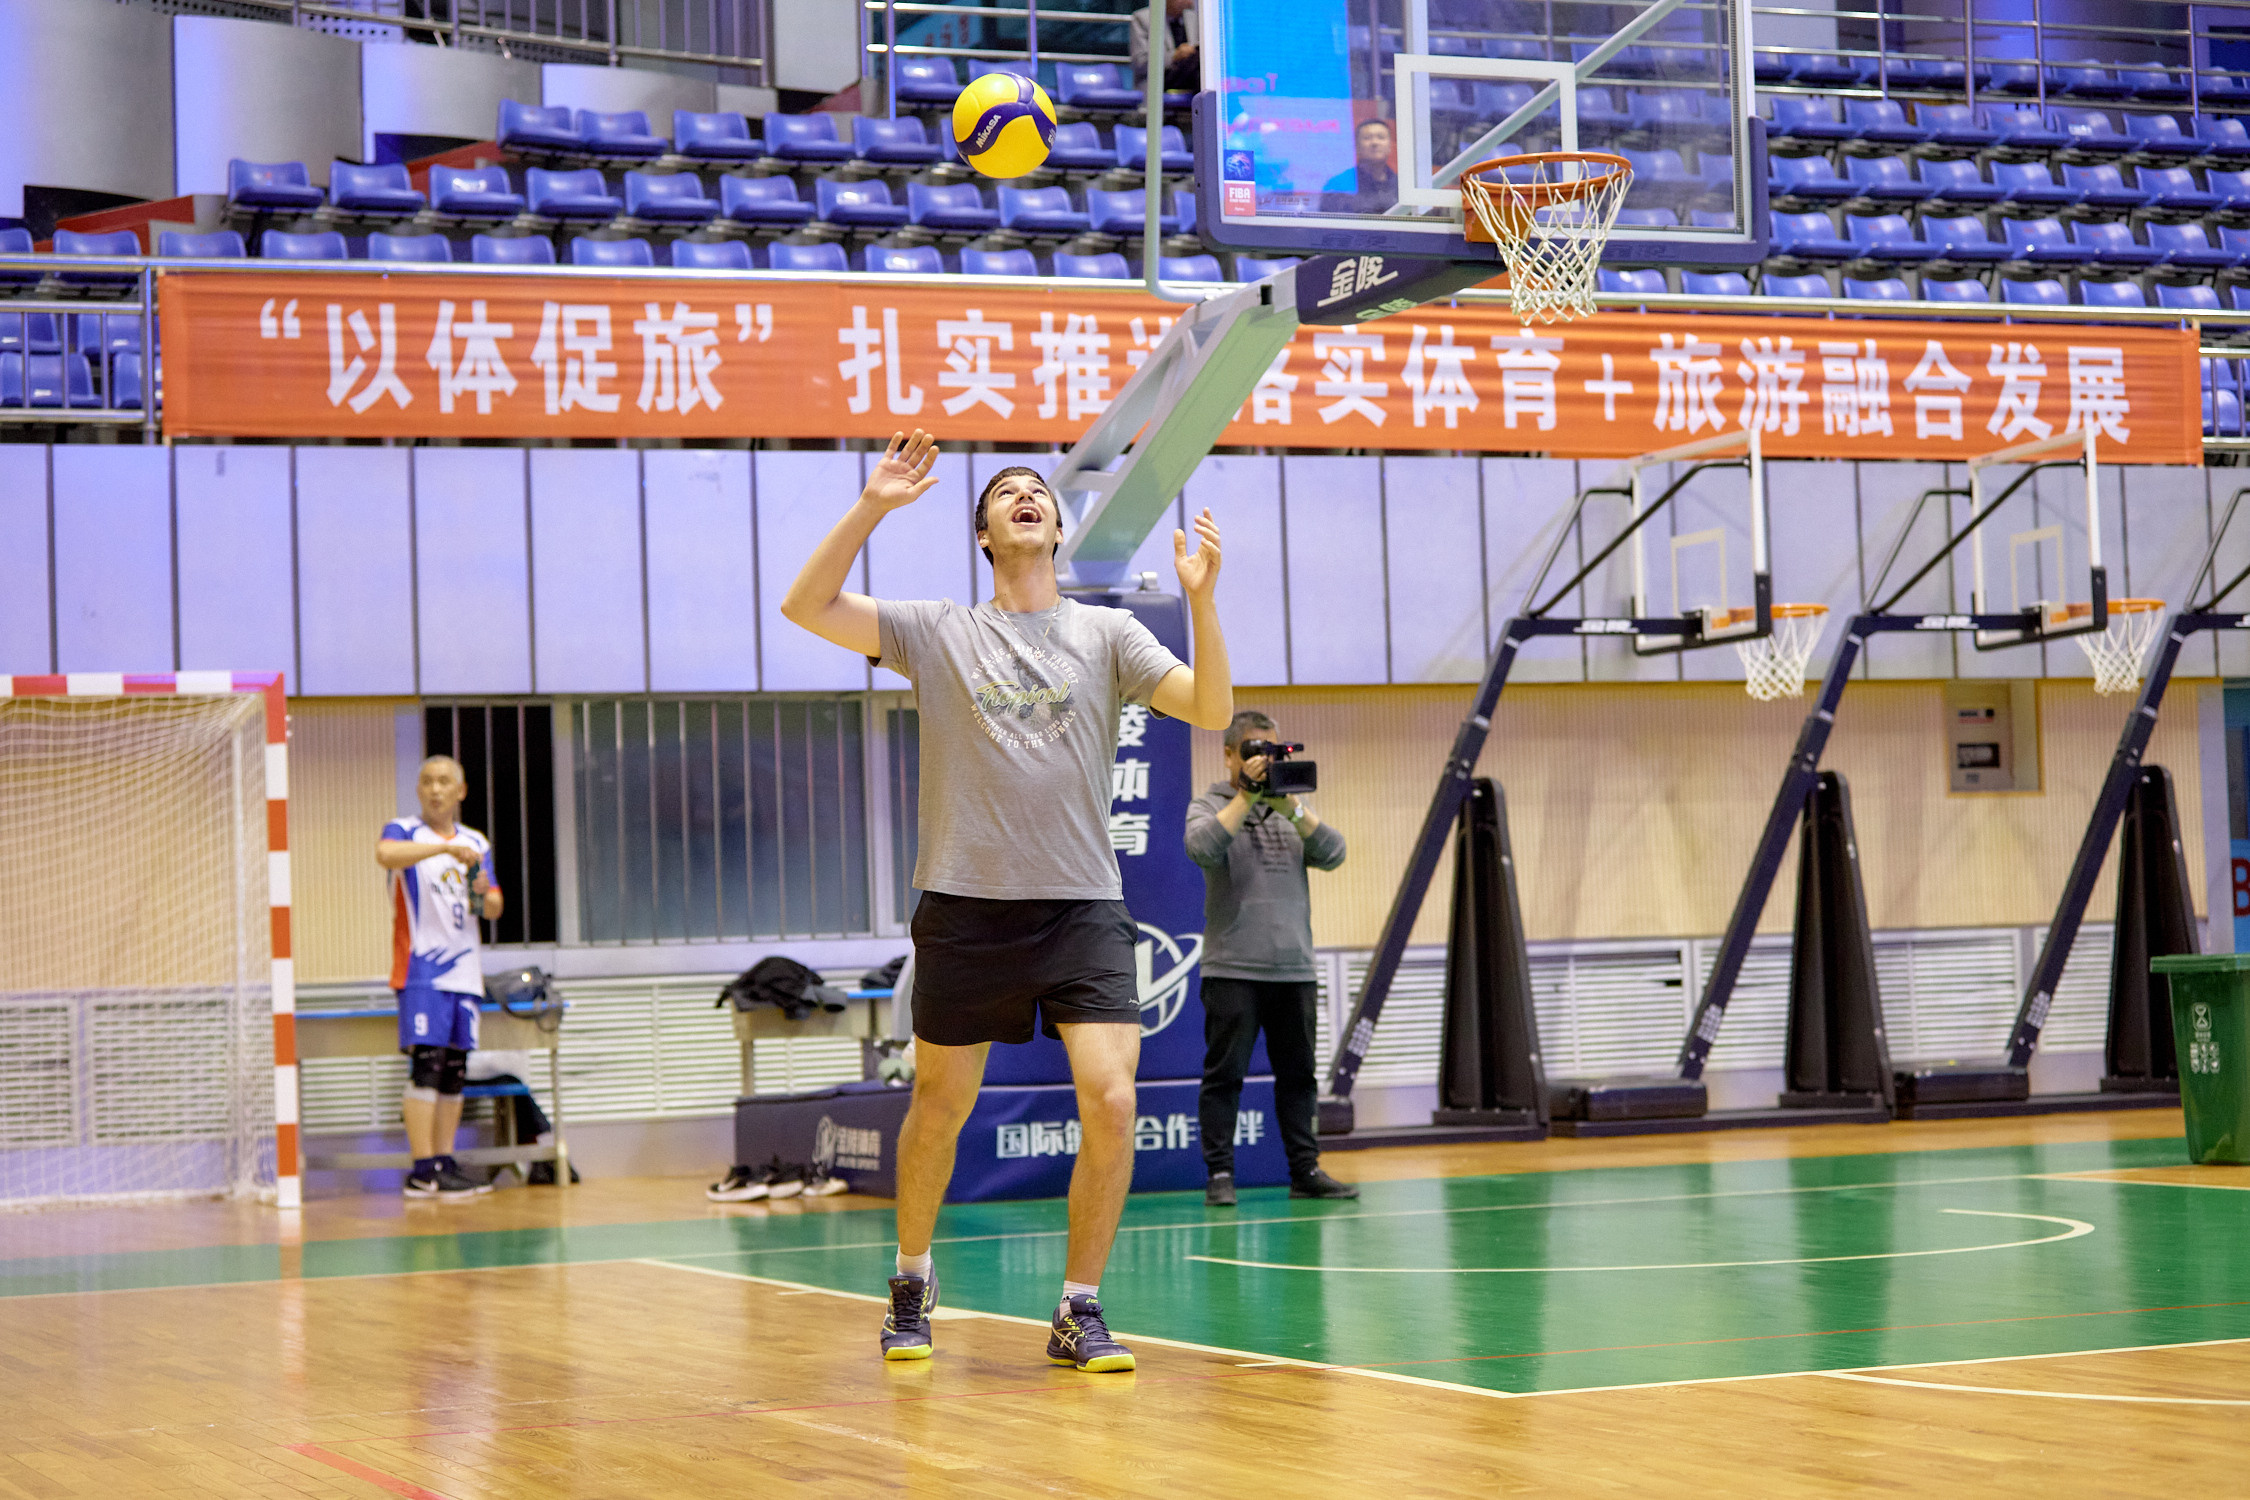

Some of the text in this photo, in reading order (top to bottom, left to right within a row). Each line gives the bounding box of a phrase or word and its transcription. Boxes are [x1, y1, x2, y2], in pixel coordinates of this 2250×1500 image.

[1228, 187, 1251, 199] FIBA
[1317, 256, 1399, 307] 金陵
[260, 298, 773, 415] “以体促旅”
[1050, 653, 1079, 684] PARROT
[976, 681, 1073, 716] Tropical
[970, 703, 1077, 749] WELCOME TO THE JUNGLE
[983, 714, 1061, 740] SUMMER ALL YEAR LONG
[452, 902, 466, 930] 9
[413, 1012, 428, 1036] 9
